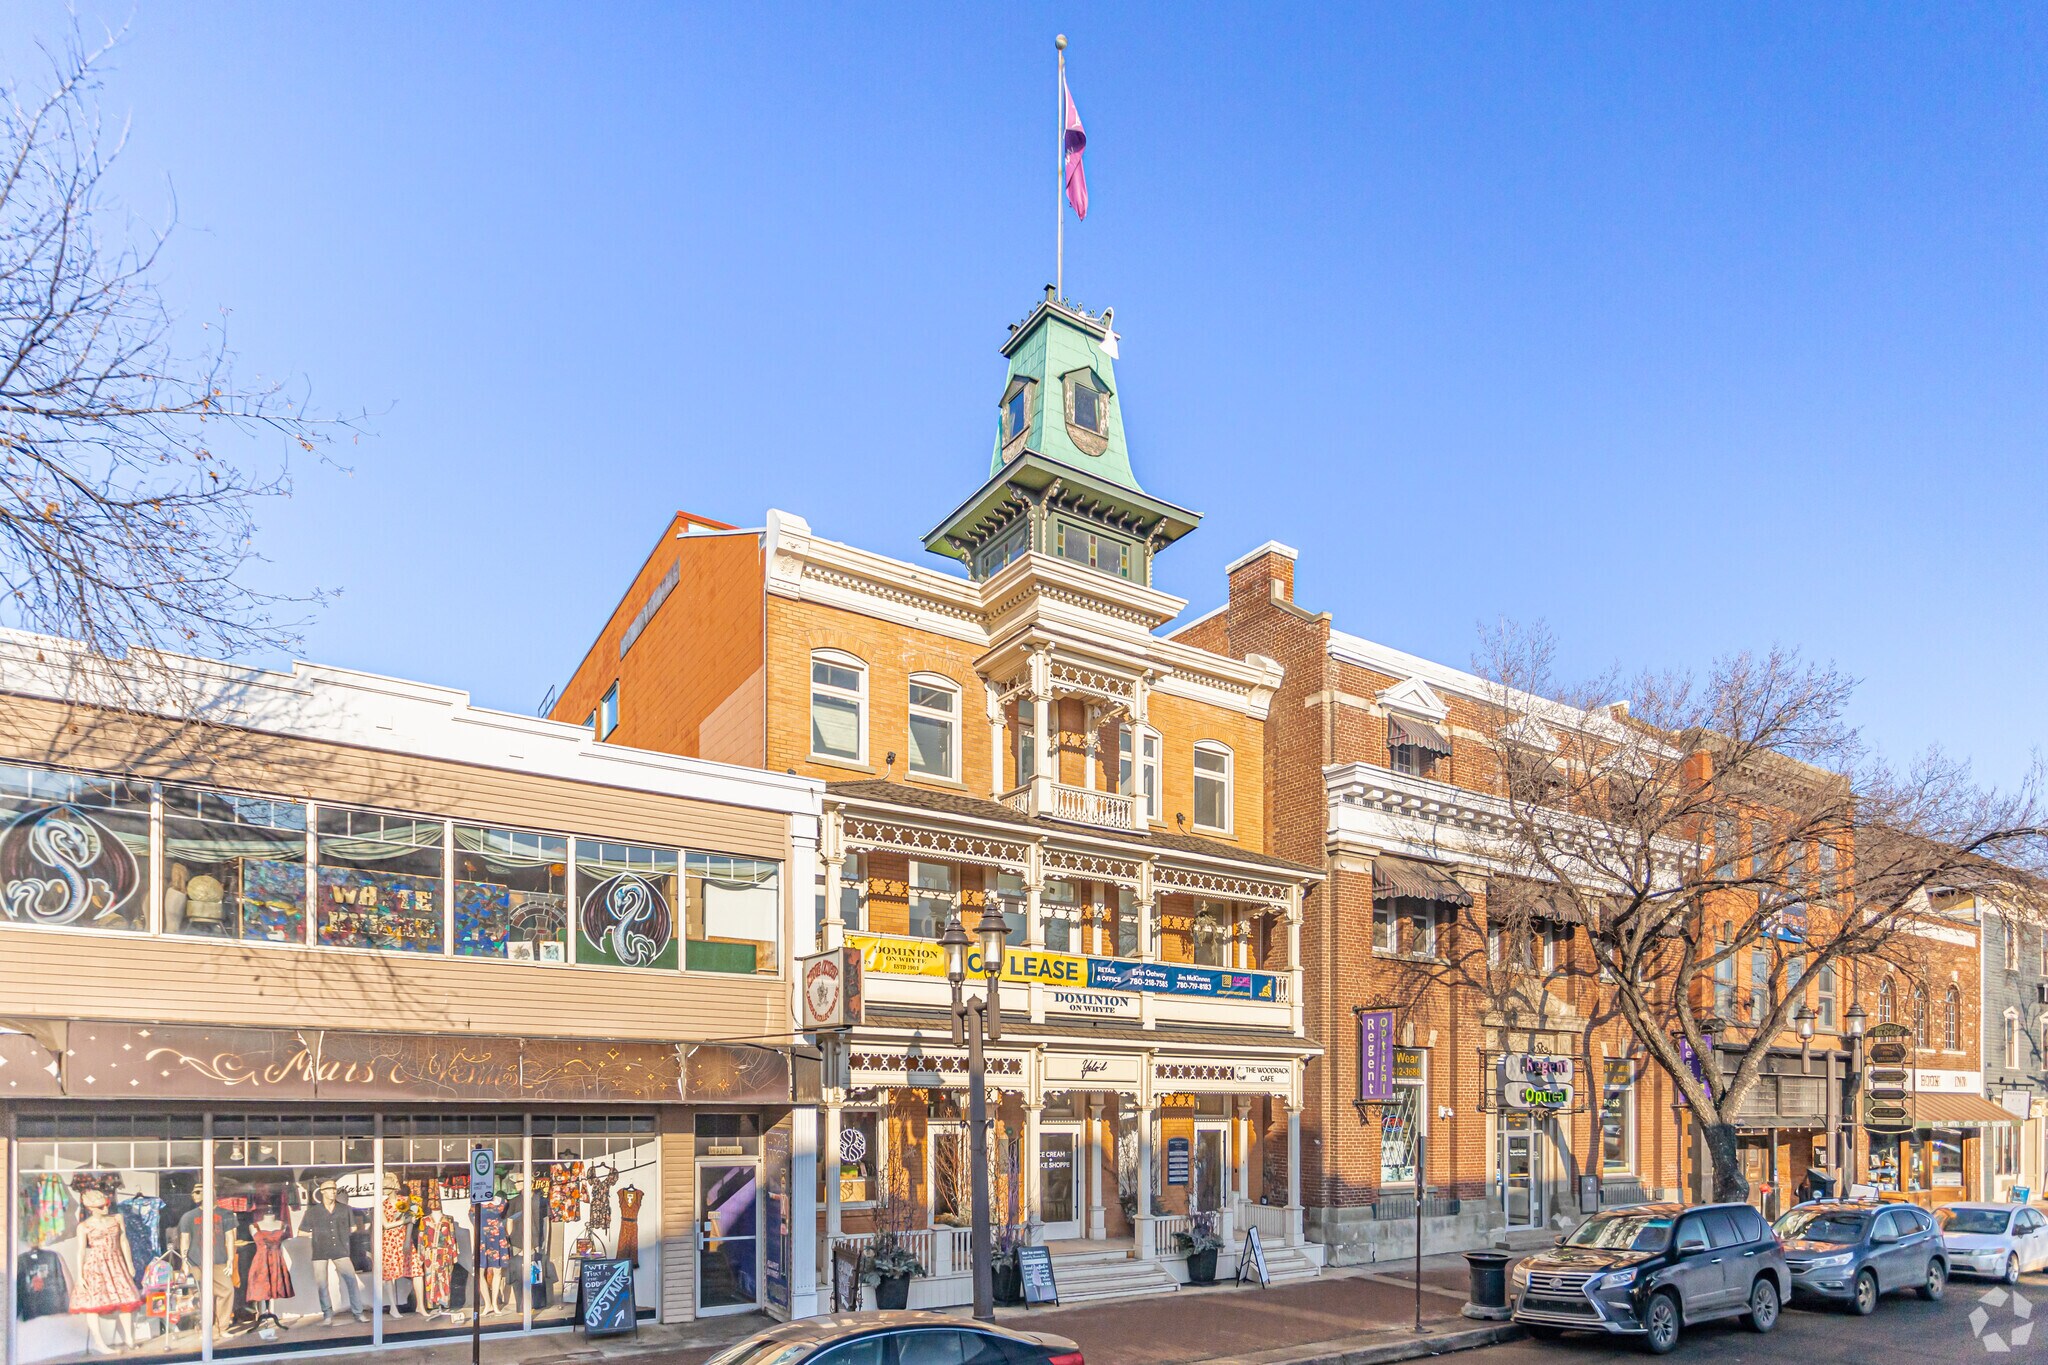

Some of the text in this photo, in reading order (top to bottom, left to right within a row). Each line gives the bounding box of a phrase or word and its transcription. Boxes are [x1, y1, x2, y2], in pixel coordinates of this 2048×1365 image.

[332, 886, 432, 911] WHTE
[873, 946, 938, 958] DOMINION
[1010, 955, 1079, 981] LEASE
[1097, 966, 1116, 974] RETAIL
[1132, 968, 1145, 976] Erin
[1055, 992, 1130, 1007] DOMINION
[1069, 1004, 1116, 1014] ON WHYTE
[1367, 1018, 1375, 1095] Regent
[1380, 1017, 1388, 1094] Optical
[1396, 1052, 1419, 1064] Wear
[1257, 1067, 1290, 1075] WOODRACK
[1526, 1056, 1568, 1075] Regent
[1260, 1075, 1275, 1083] CAFE
[1525, 1088, 1569, 1105] Optical
[586, 1272, 632, 1327] UPSTAIRS
